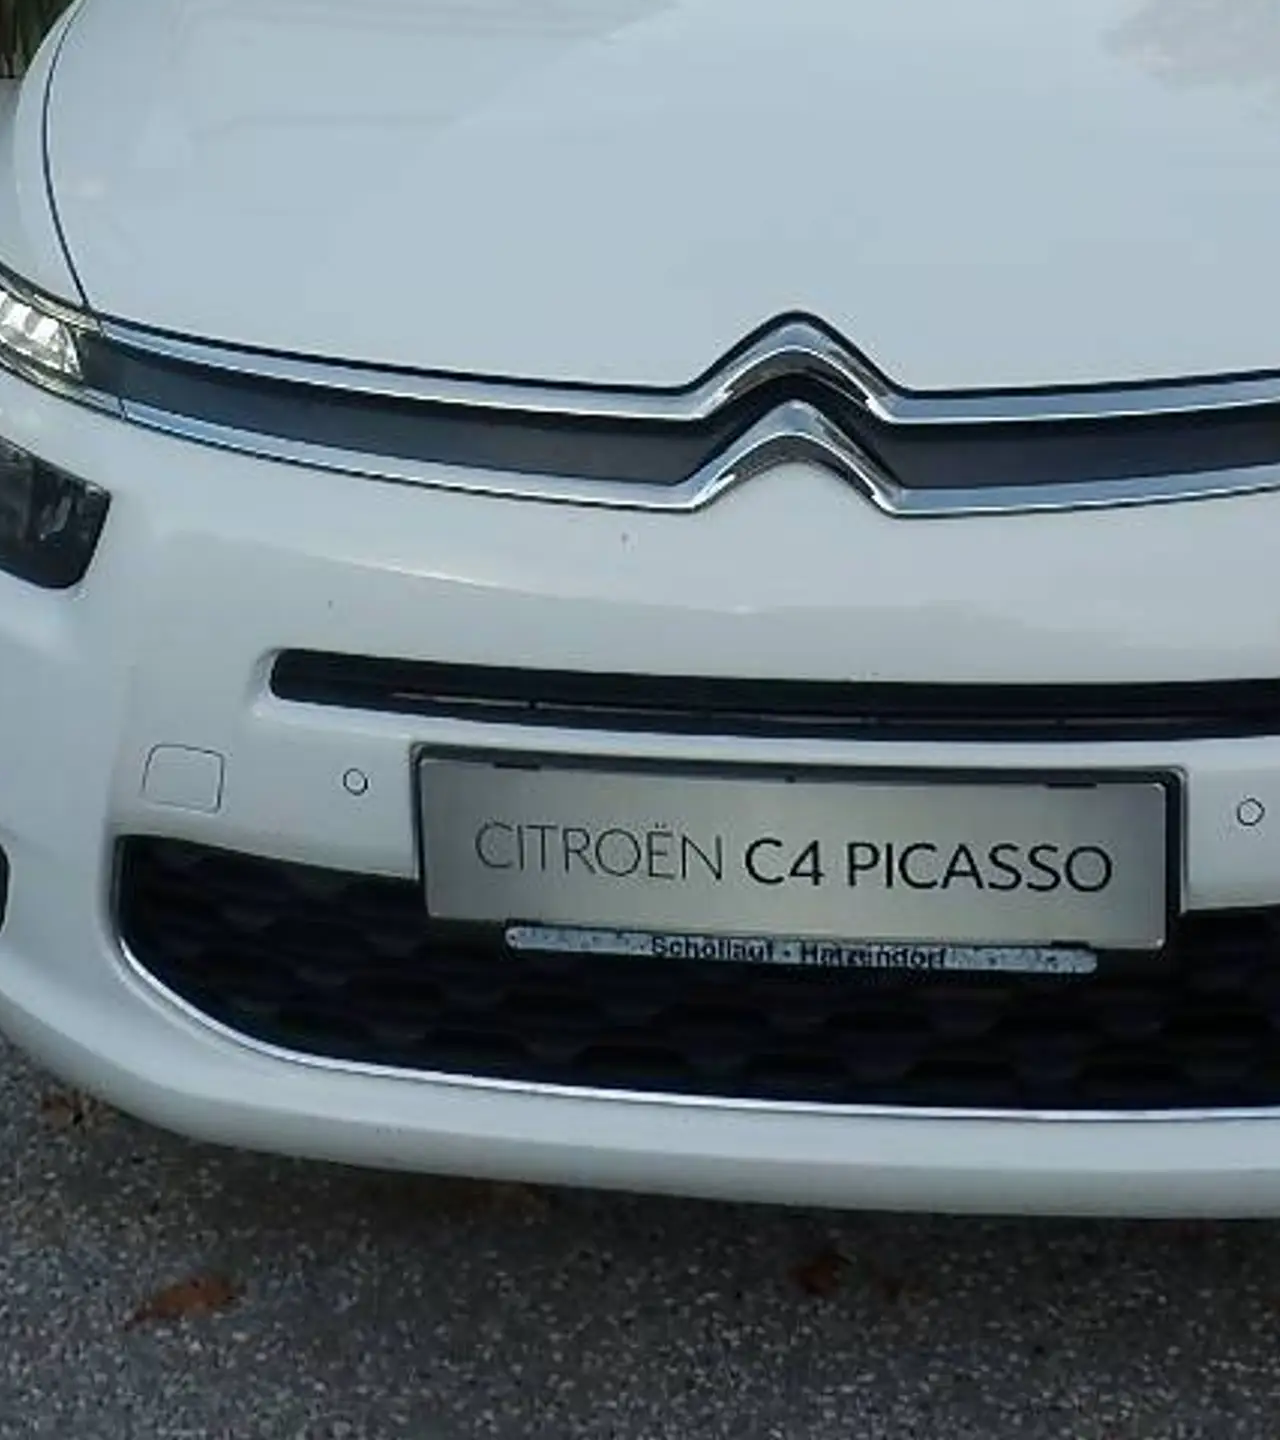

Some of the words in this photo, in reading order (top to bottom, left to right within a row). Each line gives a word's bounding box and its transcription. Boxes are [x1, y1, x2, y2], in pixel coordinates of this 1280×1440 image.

[475, 821, 722, 880] CITROËN
[745, 837, 824, 886] C4
[847, 843, 1113, 892] PICASSO
